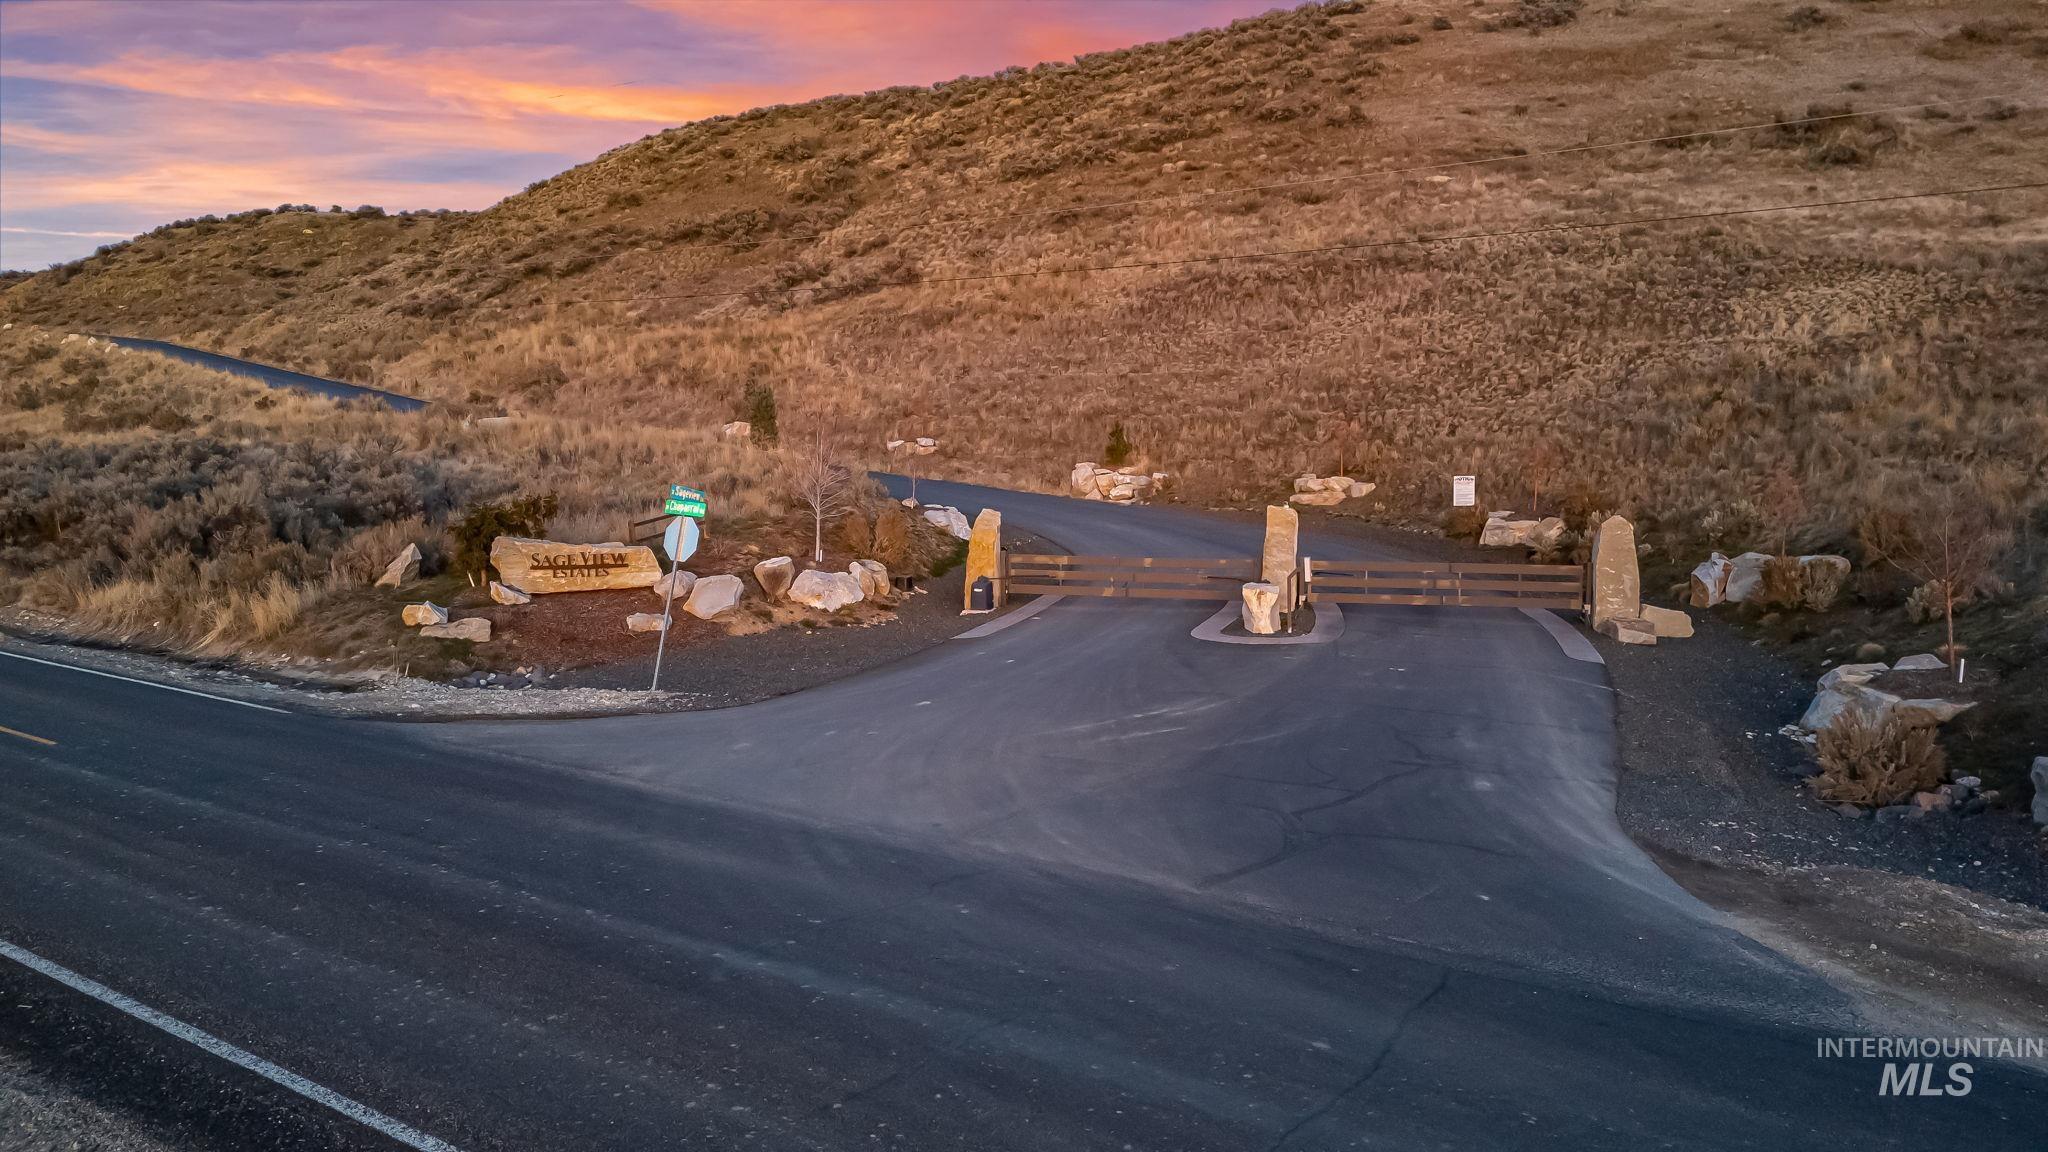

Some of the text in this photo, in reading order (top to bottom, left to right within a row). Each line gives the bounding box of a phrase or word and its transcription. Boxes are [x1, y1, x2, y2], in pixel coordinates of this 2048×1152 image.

[530, 551, 628, 567] SAGE VIEW
[552, 567, 610, 579] ESTATES
